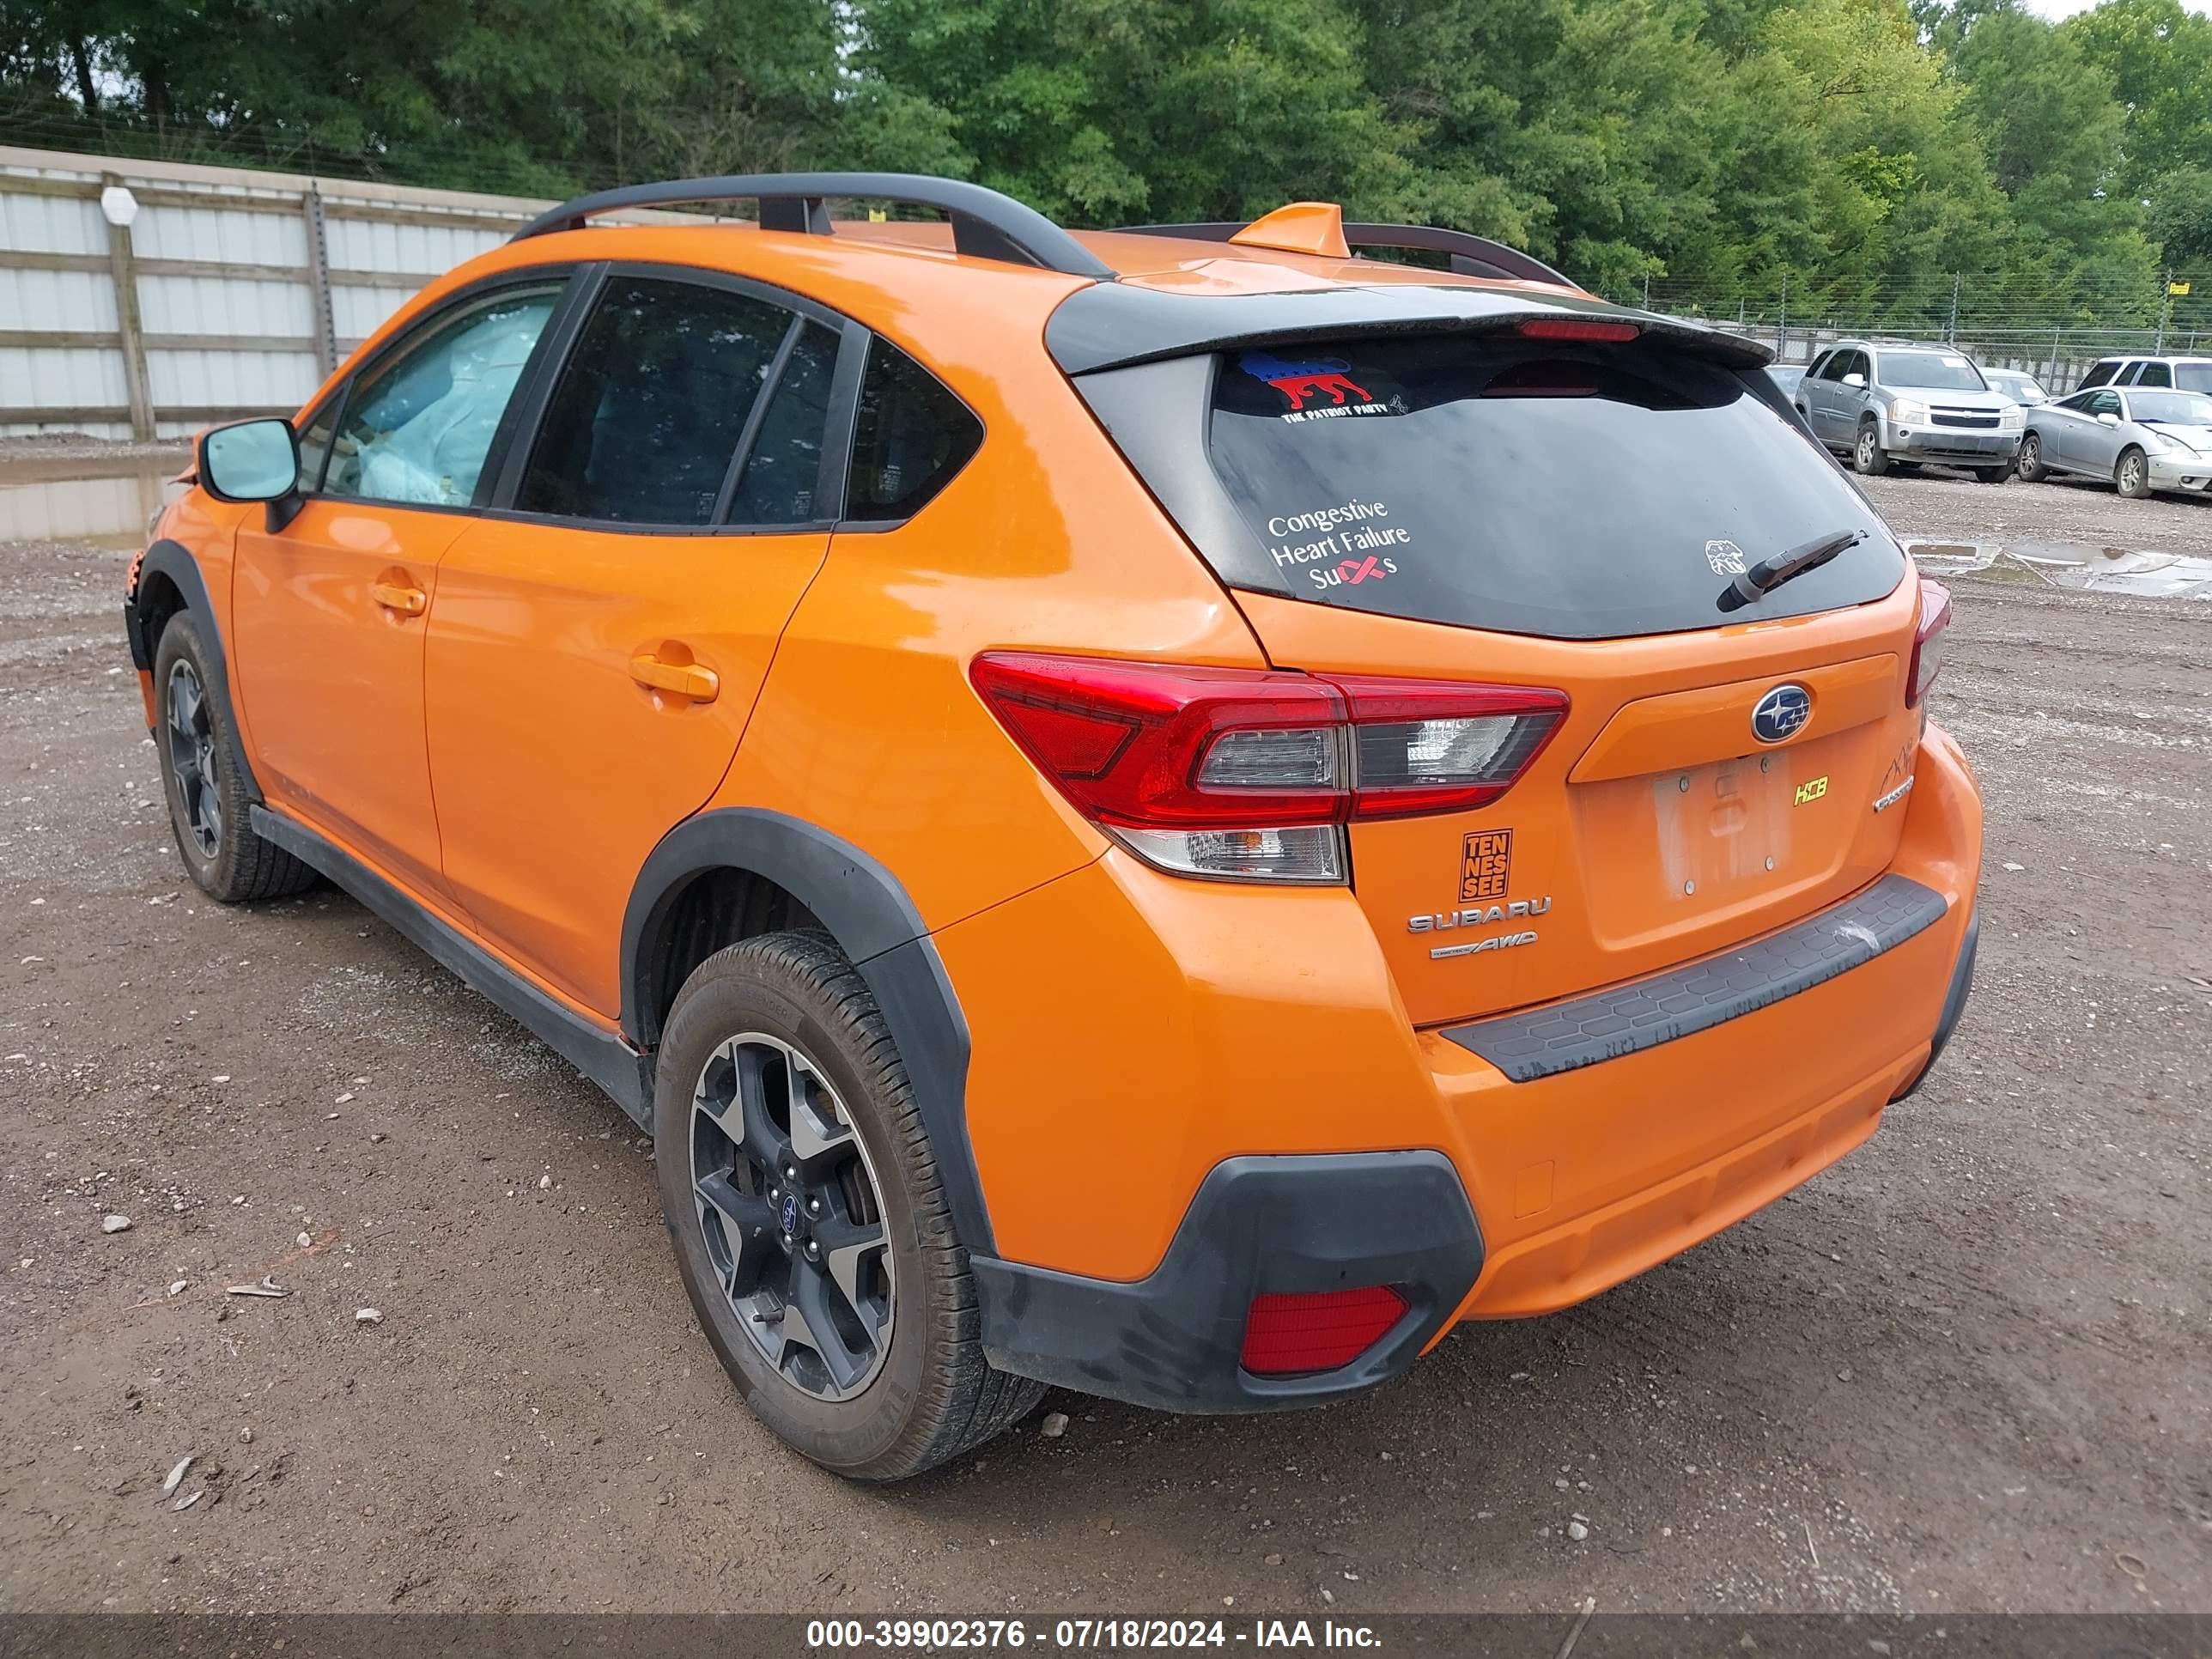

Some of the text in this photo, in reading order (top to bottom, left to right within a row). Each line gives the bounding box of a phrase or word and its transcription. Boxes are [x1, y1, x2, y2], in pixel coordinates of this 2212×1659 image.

[1281, 404, 1389, 424] THE PATRIOT PARTY
[1268, 498, 1389, 537] Congestive
[1270, 526, 1411, 568] Heart Failure
[1408, 896, 1552, 933] SUBARU
[1473, 931, 1539, 954] AWD
